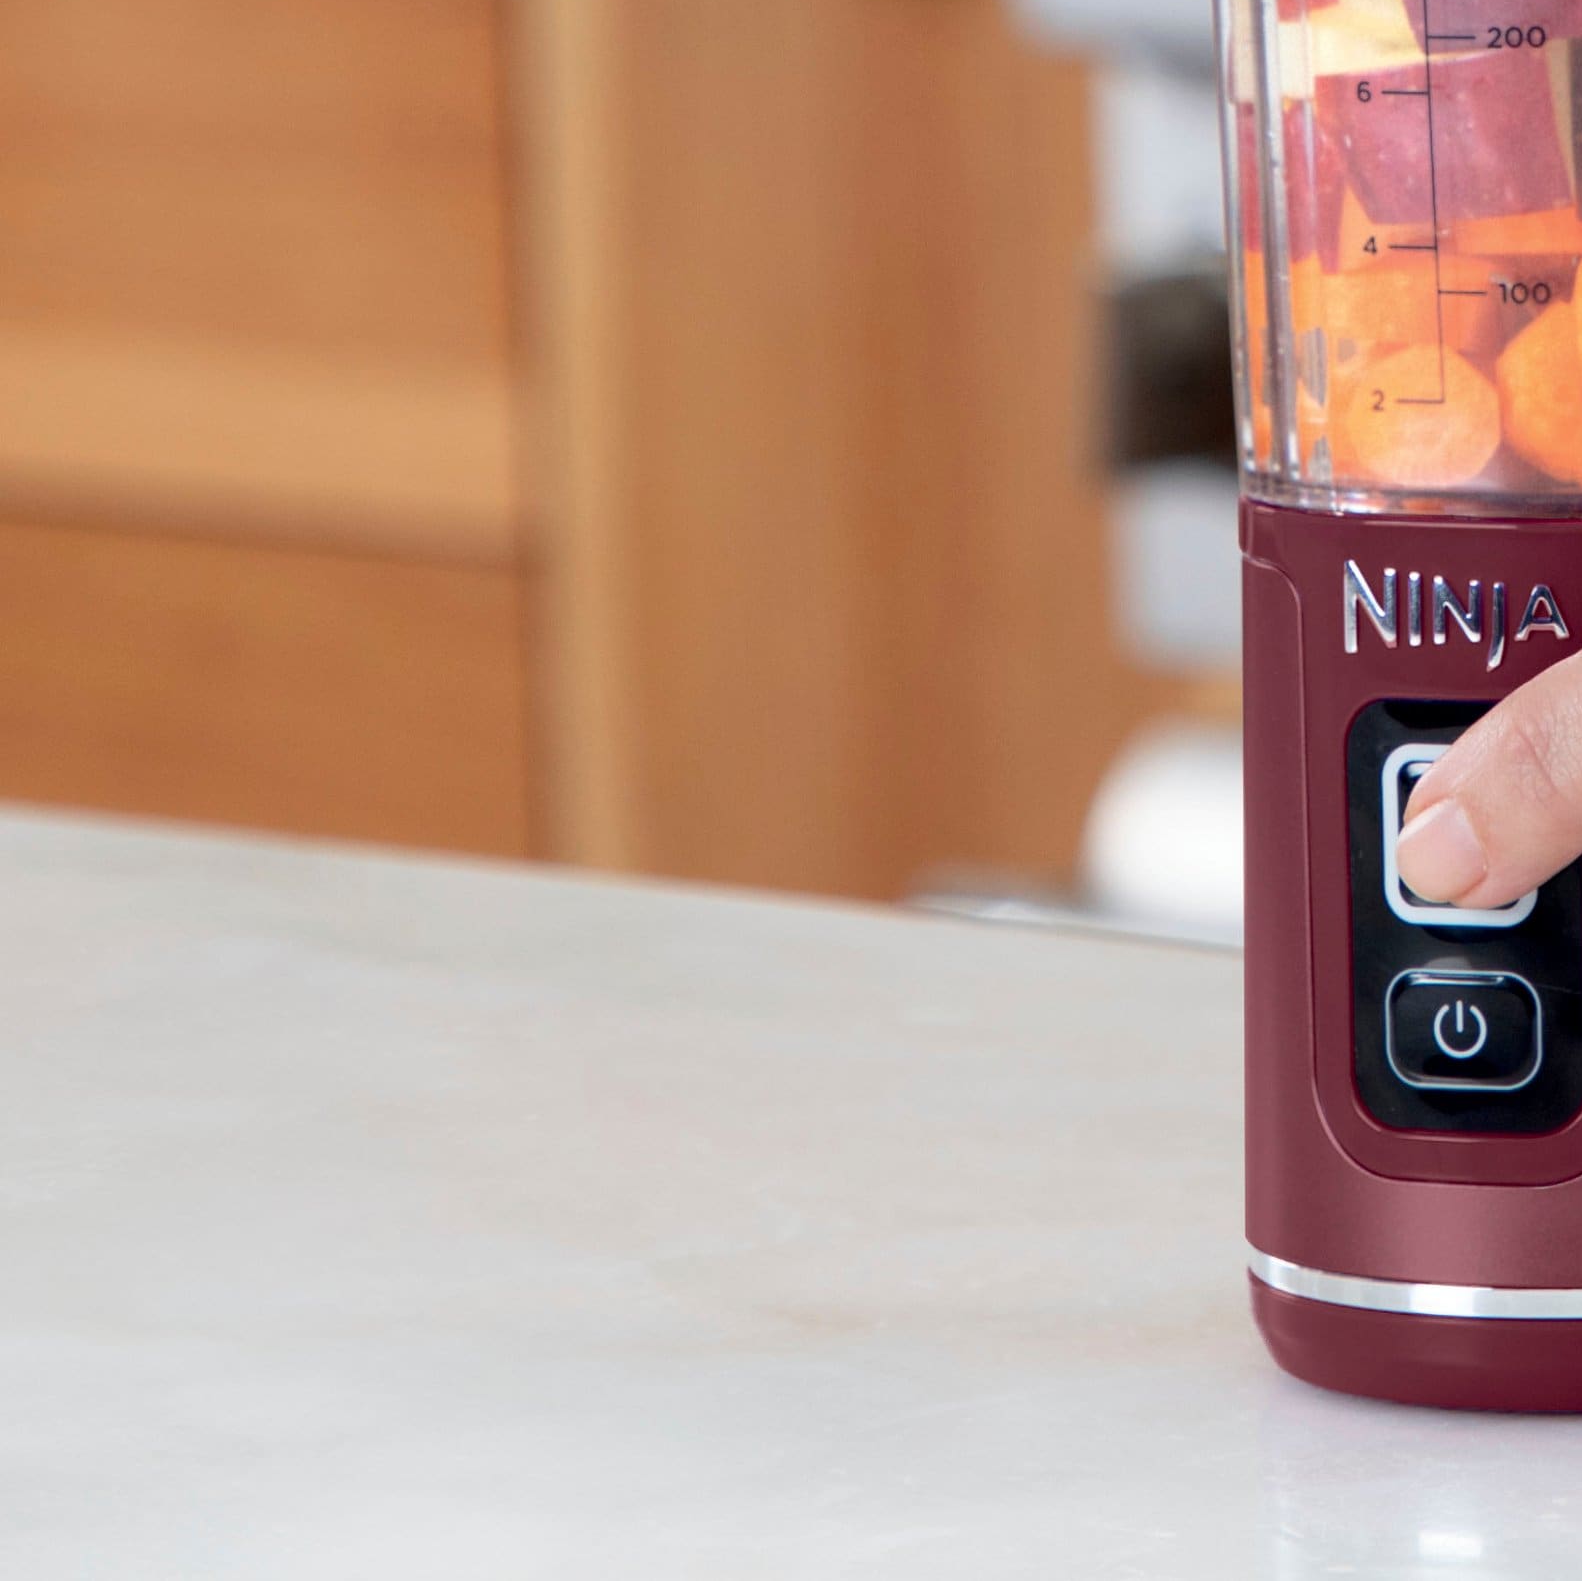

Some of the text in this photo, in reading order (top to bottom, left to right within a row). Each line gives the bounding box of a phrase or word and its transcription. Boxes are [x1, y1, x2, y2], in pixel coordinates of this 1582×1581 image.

[1487, 26, 1547, 49] 200
[1356, 81, 1372, 103] 6
[1363, 236, 1378, 255] 4
[1498, 282, 1552, 305] 100
[1372, 390, 1385, 412] 2
[1343, 559, 1569, 673] NINJA
